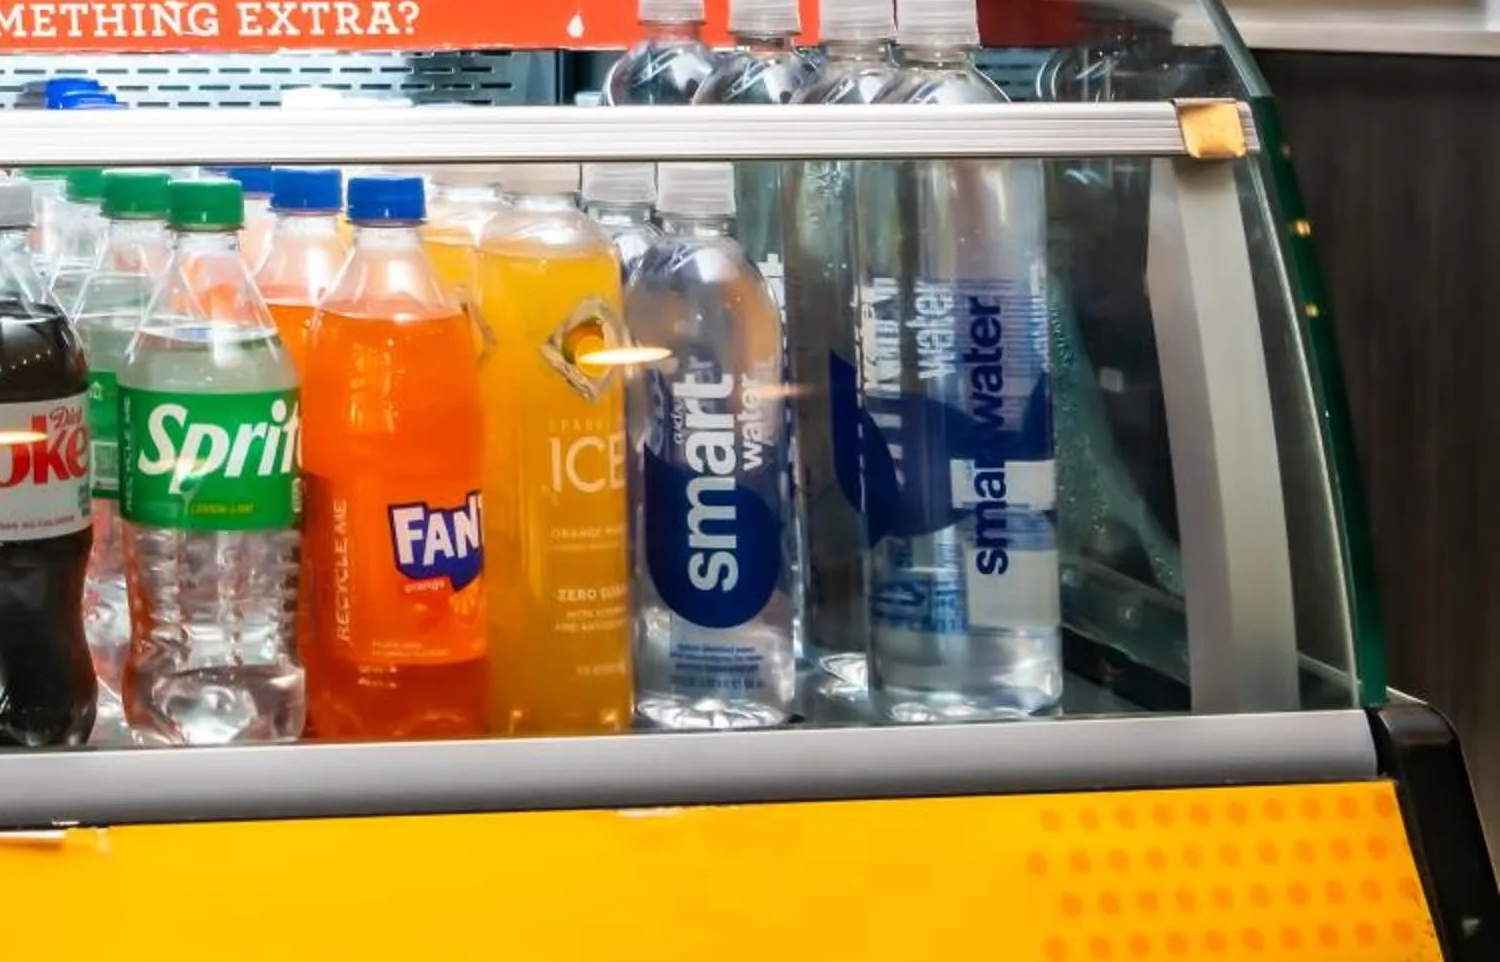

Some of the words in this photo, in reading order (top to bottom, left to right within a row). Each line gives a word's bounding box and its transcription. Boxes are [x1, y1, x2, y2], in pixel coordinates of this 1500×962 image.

[237, 1, 420, 36] EXTRA?
[962, 296, 1004, 428] water
[551, 431, 626, 493] ICE
[672, 373, 738, 592] smart
[737, 373, 763, 471] water
[333, 499, 347, 533] ME
[334, 538, 350, 641] RECYCLE
[557, 589, 597, 601] ZERO
